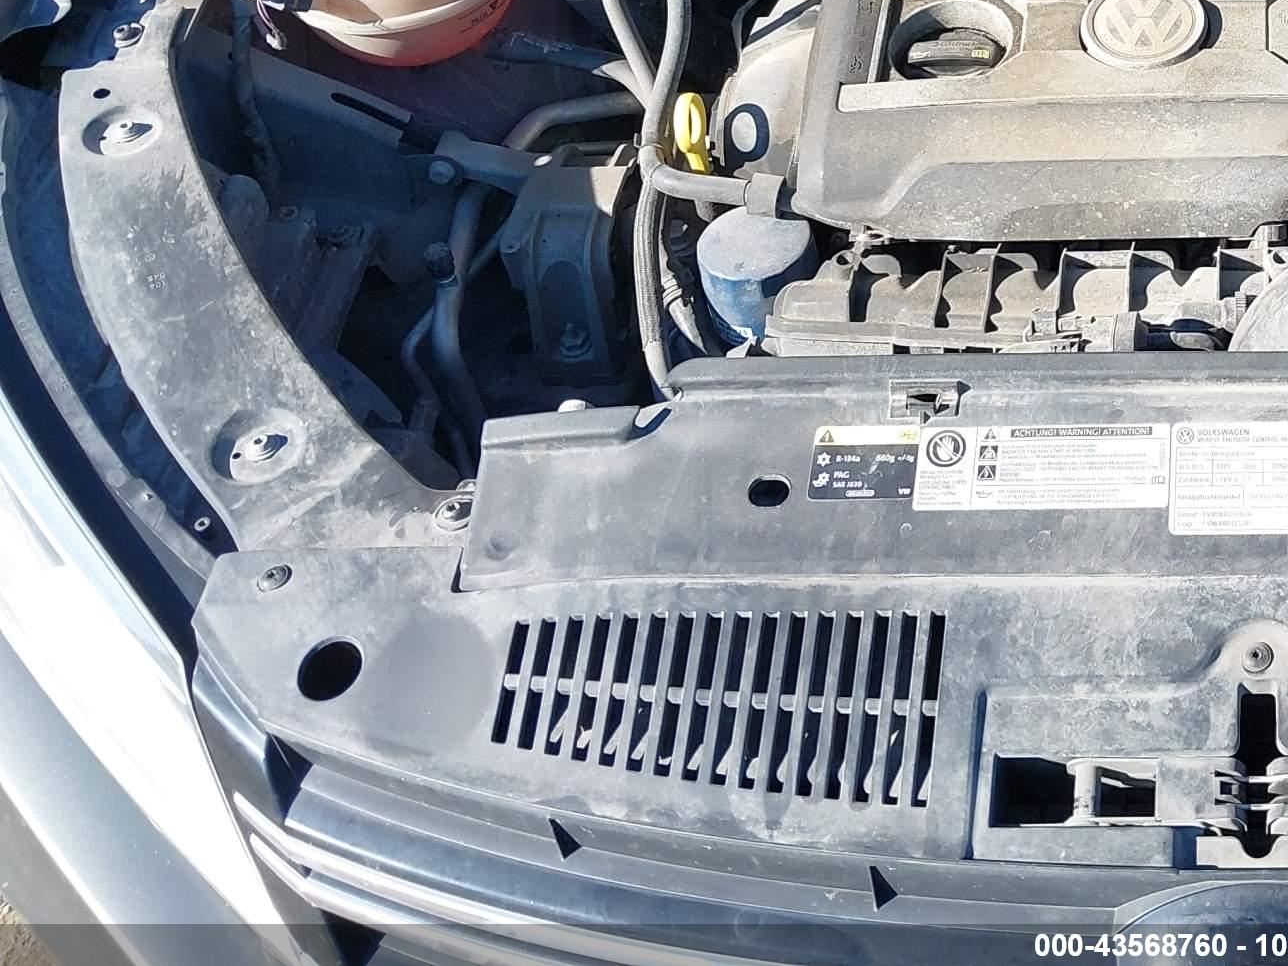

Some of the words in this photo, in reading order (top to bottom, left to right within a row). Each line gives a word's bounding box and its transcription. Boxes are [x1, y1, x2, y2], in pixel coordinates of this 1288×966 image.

[1013, 429, 1057, 437] ACHTUNG!
[1058, 428, 1101, 436] WARNING!
[1103, 427, 1150, 435] ATTENTION!
[835, 455, 861, 463] R-134a
[833, 471, 850, 479] PAG
[898, 487, 912, 495] VW
